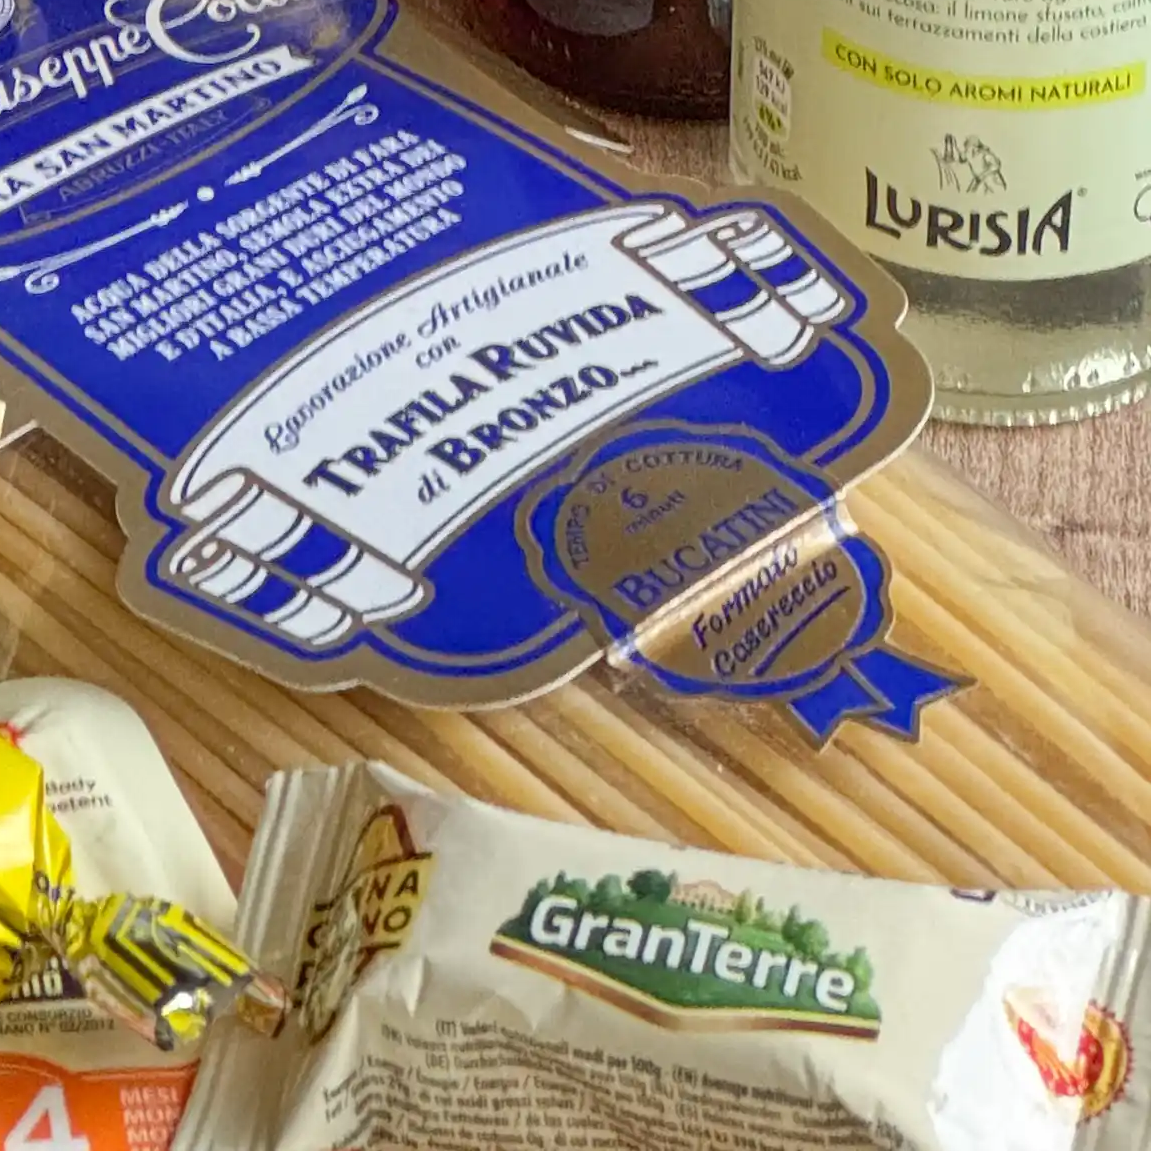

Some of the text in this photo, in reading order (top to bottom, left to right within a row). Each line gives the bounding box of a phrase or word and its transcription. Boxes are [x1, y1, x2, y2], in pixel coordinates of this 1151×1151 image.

[858, 0, 881, 18] sui
[887, 7, 1020, 44] terrazzamenti
[1026, 24, 1074, 44] della
[947, 0, 956, 17] il
[964, 1, 1029, 23] limone
[834, 44, 1132, 104] CON SOLO AROMI NATURALI
[42, 132, 110, 181] SAN
[113, 56, 284, 141] MARTINO
[865, 166, 1073, 256] LURISIA
[144, 232, 222, 280] DELLA
[213, 248, 290, 297] GRANI
[417, 249, 589, 337] Artigianale
[84, 305, 137, 345] SAN
[210, 339, 235, 361] A
[415, 334, 461, 370] con
[303, 292, 665, 497] TRAFILA RUVIDA
[416, 363, 620, 504] di BRONZO
[624, 450, 743, 473] COTTURA
[620, 486, 648, 510] 6
[614, 487, 799, 610] BUCATINI
[713, 559, 839, 678] Casereccio
[529, 895, 856, 1013] GranTerre
